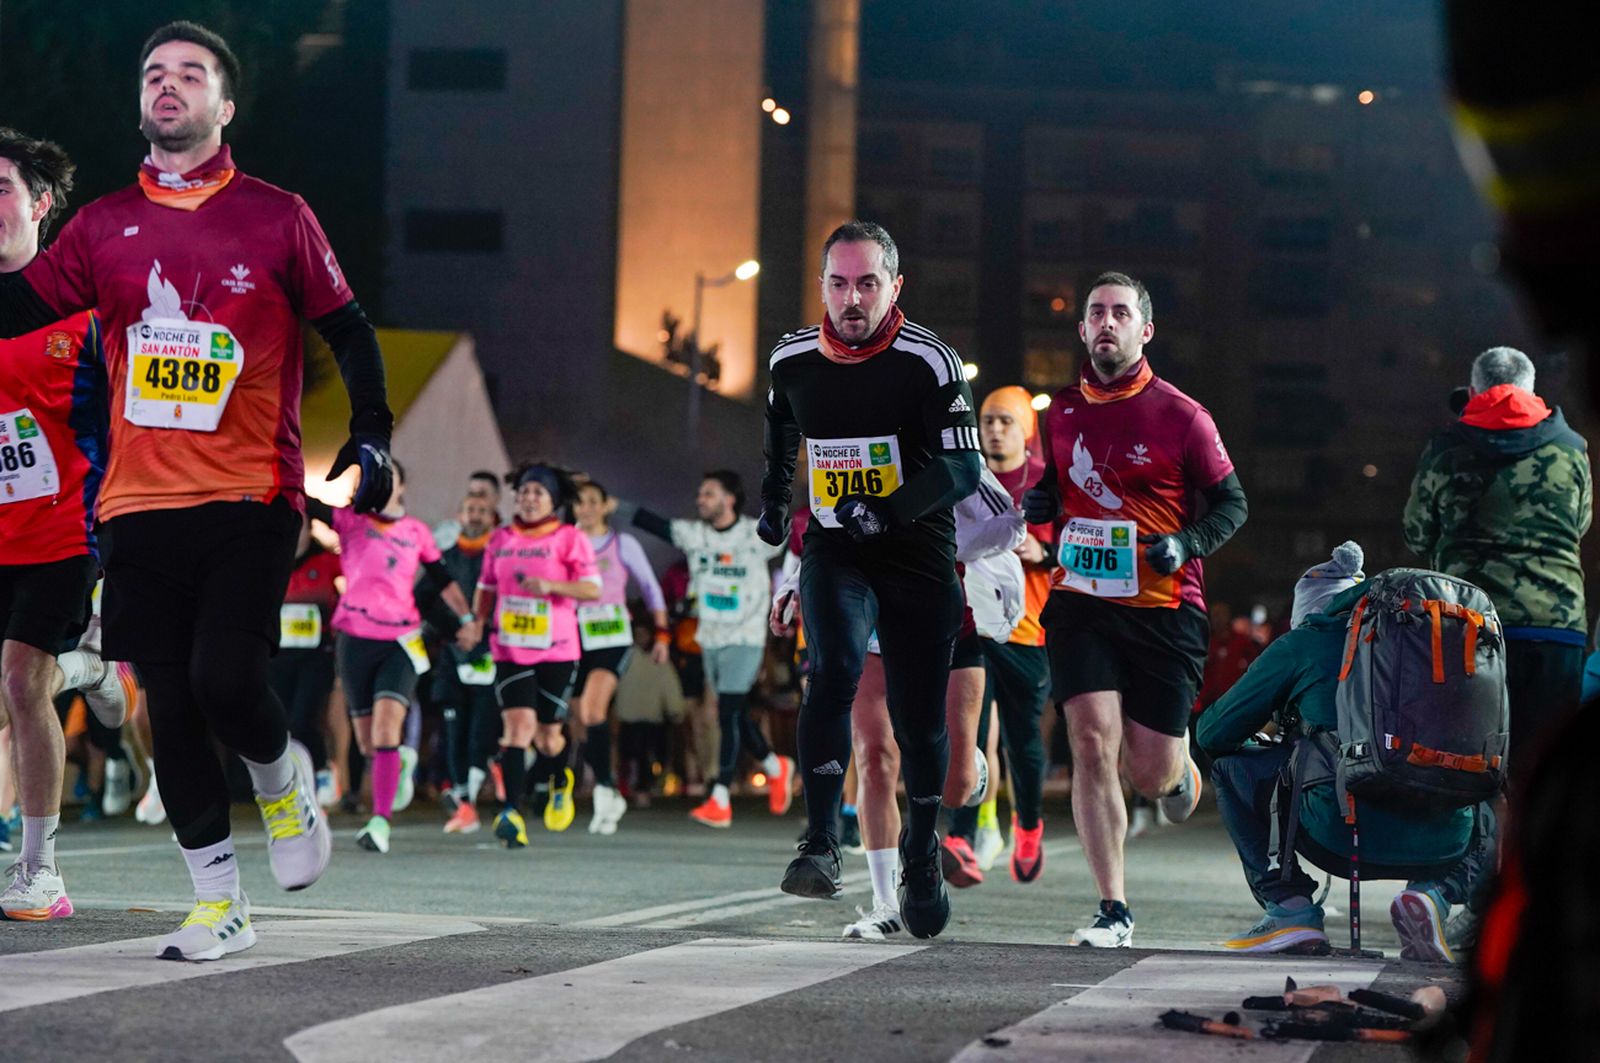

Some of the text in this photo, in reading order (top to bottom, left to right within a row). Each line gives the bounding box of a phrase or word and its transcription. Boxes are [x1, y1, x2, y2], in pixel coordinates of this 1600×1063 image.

[153, 331, 200, 344] NOCHE DE
[141, 343, 161, 354] SAN
[161, 344, 200, 358] ANTÓN
[145, 357, 221, 393] 4388
[161, 392, 198, 402] Pedro Luis
[948, 404, 971, 413] adidas
[0, 442, 36, 472] 86
[822, 448, 861, 458] NOCHE DE
[816, 459, 832, 469] SAN
[832, 457, 862, 469] ANTÓN
[825, 468, 884, 498] 3746
[1083, 476, 1104, 498] 43
[1076, 526, 1094, 536] NOCHE
[1094, 529, 1104, 537] DE
[1073, 545, 1118, 572] 7976
[812, 766, 844, 775] adidas
[1247, 918, 1277, 936] HOKA
